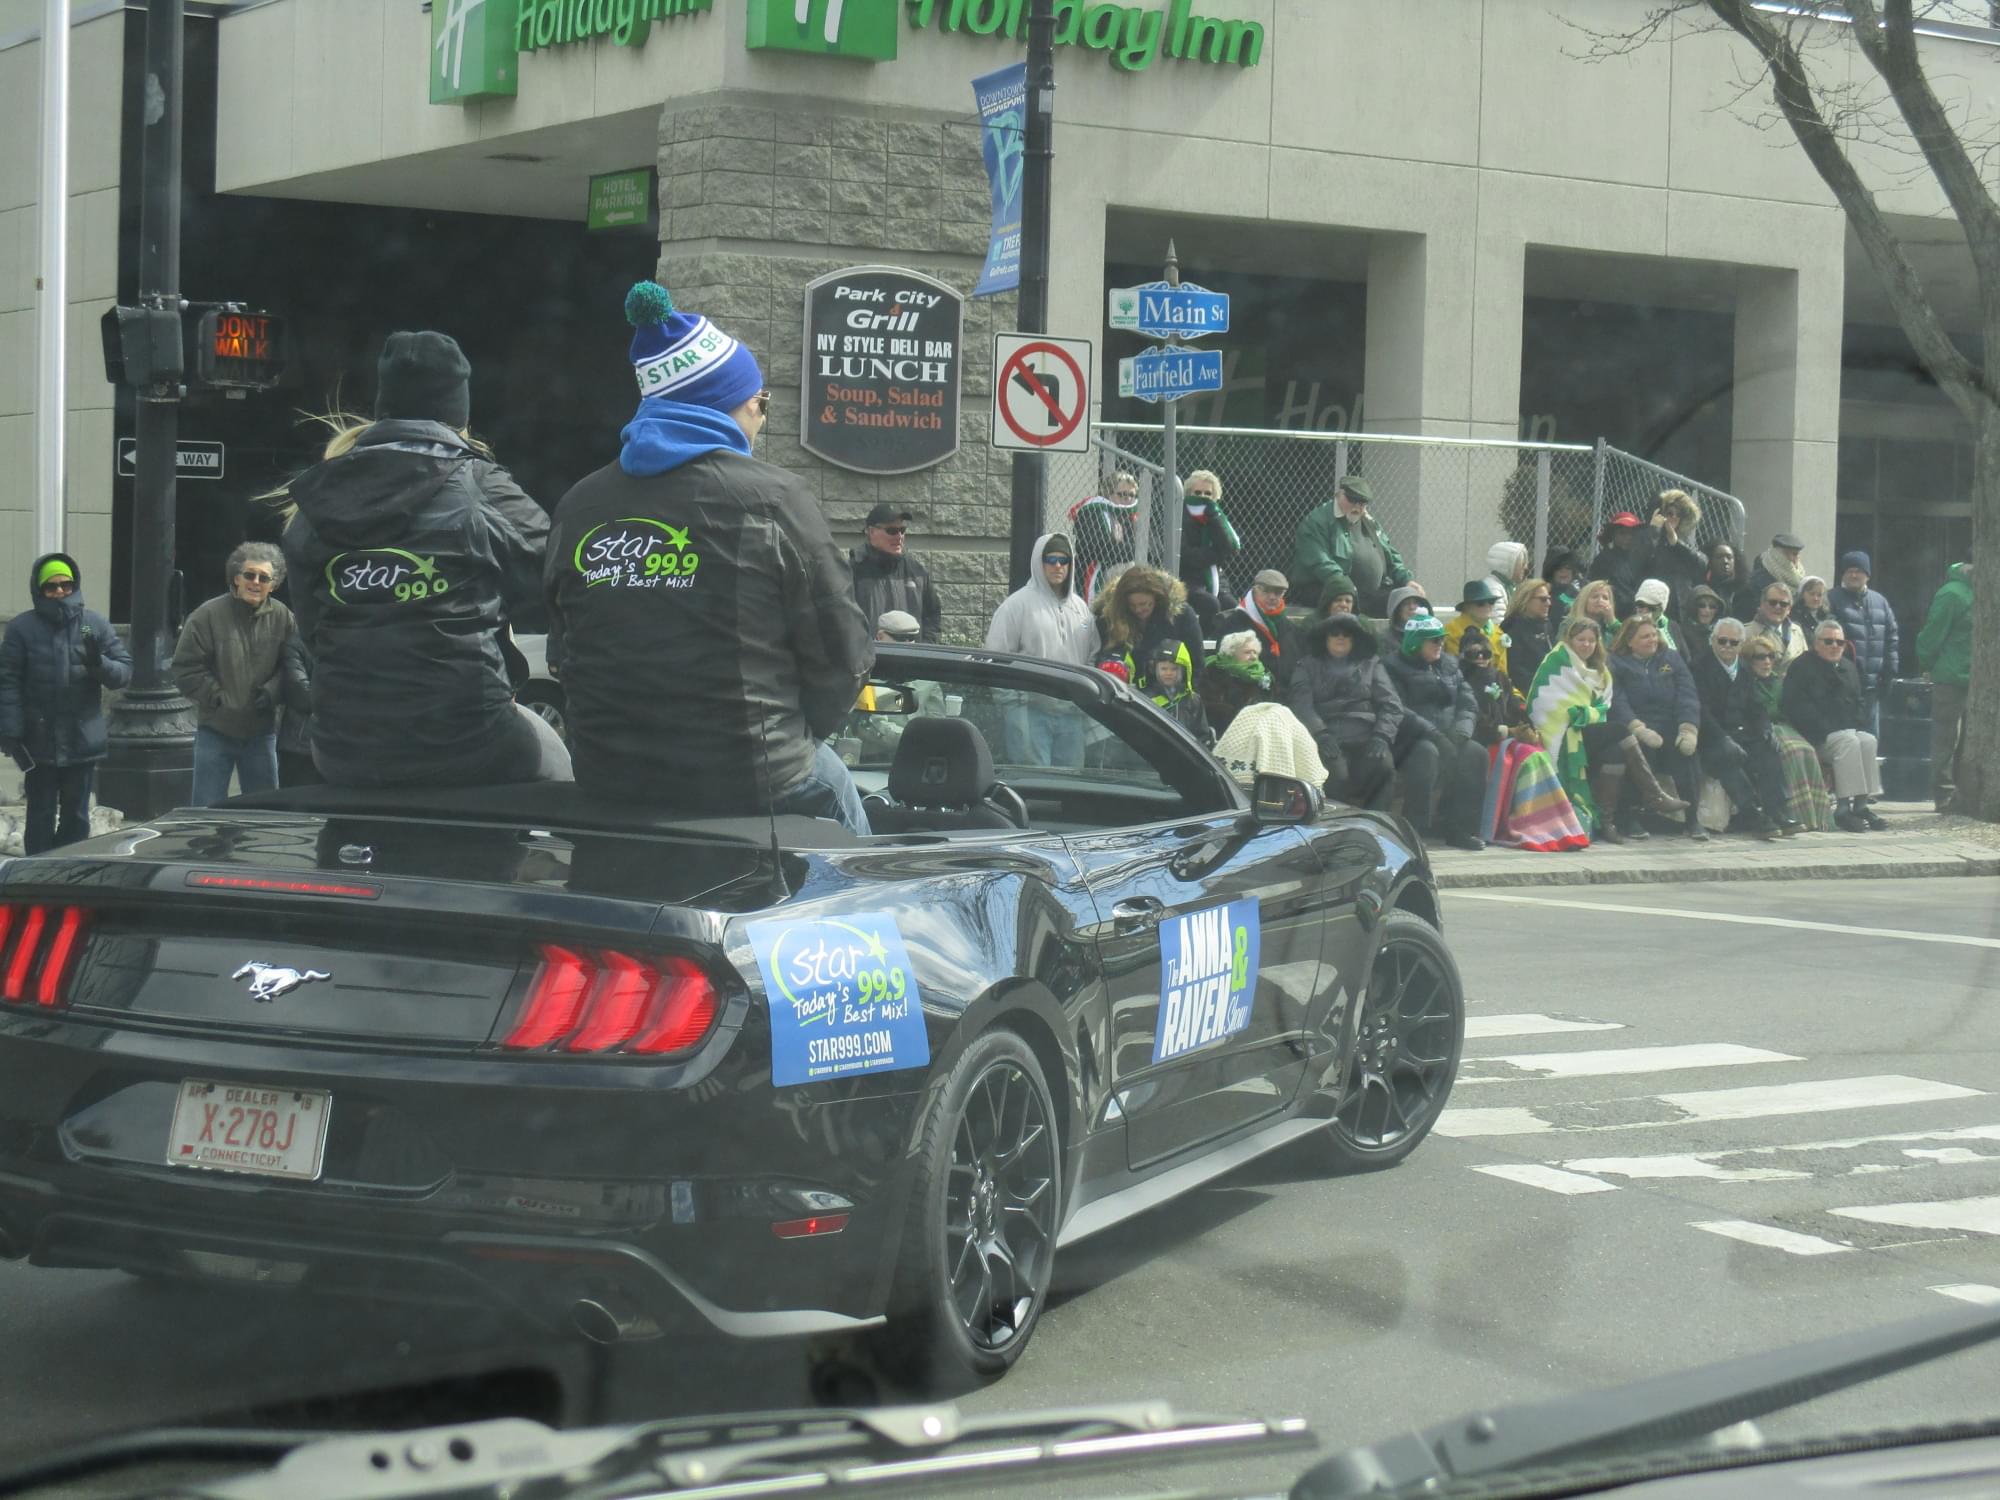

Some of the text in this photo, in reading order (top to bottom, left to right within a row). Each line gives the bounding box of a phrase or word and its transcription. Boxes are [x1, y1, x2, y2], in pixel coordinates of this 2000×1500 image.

[908, 0, 1265, 71] olday Inn
[602, 178, 637, 195] HOTEL
[595, 192, 643, 211] PARKING
[834, 286, 942, 309] Park City
[1143, 296, 1224, 325] Main St
[846, 308, 920, 333] Grill
[817, 333, 953, 359] NY STYLE DELI BAR
[647, 349, 703, 385] STAR
[818, 355, 949, 383] LUNCH
[1135, 358, 1218, 390] Fairfield Ave
[826, 383, 944, 408] Soup, Salad
[820, 405, 942, 430] & Sandwich
[183, 453, 212, 465] WAY
[587, 530, 699, 576] star 99.9
[340, 560, 410, 590] star
[582, 559, 696, 588] Today's Best Mix!
[1167, 906, 1249, 992] The ANNA &
[790, 938, 906, 1005] star 99.9
[793, 981, 908, 1026] Today's Best Mix!
[1160, 973, 1249, 1059] RAVEN Show
[809, 1030, 893, 1063] STAR999.COM
[225, 1088, 279, 1105] DEALER
[201, 1147, 281, 1167] CONNECTICUT
